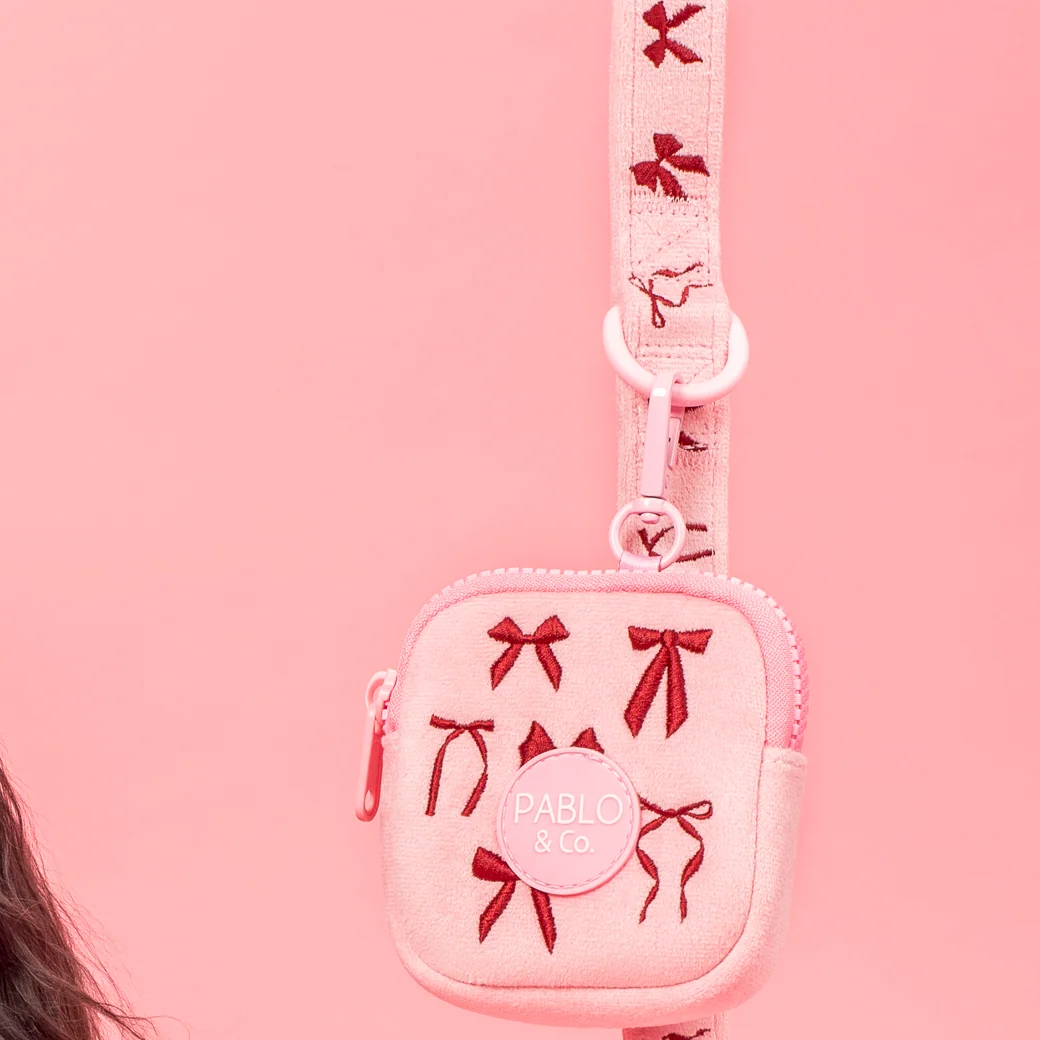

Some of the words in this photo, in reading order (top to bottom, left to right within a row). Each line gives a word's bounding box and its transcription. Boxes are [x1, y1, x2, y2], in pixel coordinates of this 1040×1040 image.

[514, 793, 623, 825] PABLO
[534, 829, 552, 853] &
[559, 830, 594, 853] Co.
